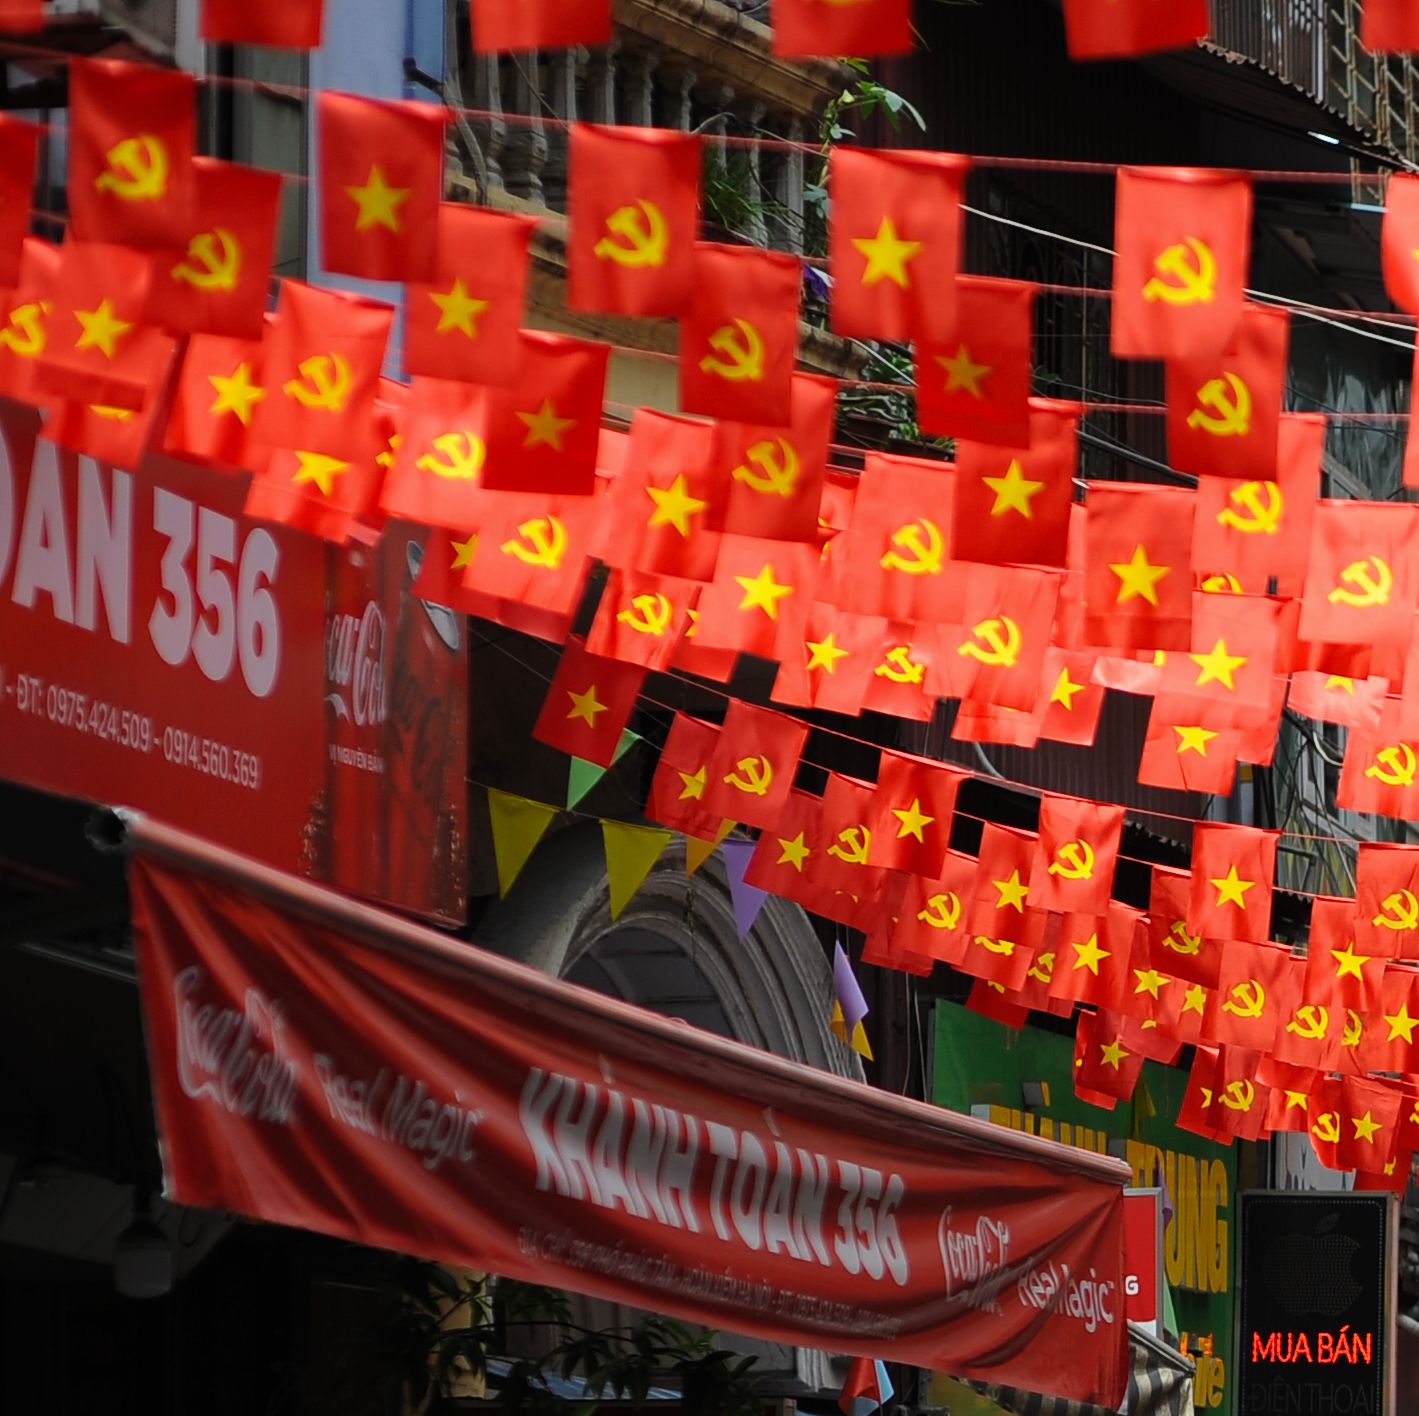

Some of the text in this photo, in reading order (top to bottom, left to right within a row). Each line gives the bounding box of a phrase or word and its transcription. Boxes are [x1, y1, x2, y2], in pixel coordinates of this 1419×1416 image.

[148, 484, 282, 697] 356
[46, 686, 152, 753] 0975.424.509
[706, 1107, 830, 1267] TOÀN
[834, 1159, 908, 1287] 356
[1251, 1323, 1373, 1365] MUA BÁN
